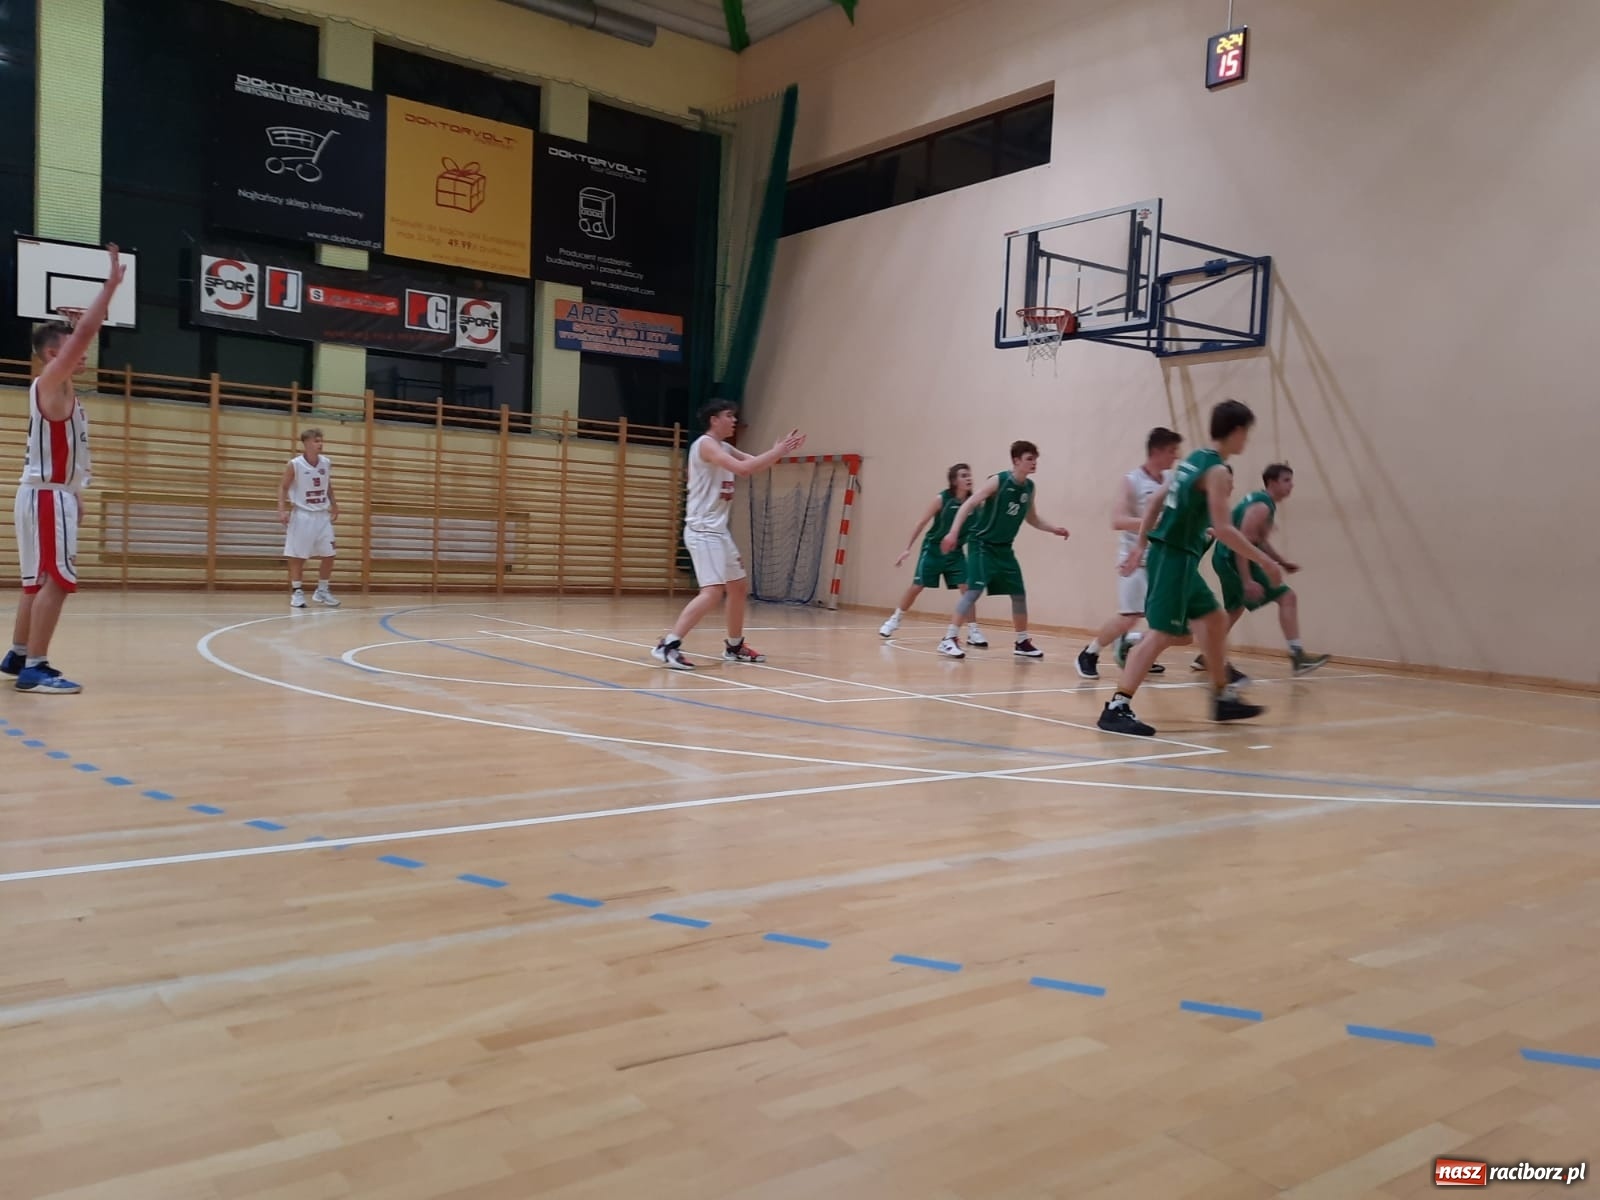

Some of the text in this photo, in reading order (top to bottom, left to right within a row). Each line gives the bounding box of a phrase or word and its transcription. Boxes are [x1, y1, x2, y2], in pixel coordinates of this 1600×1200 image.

[1218, 49, 1240, 77] 15
[236, 73, 368, 109] DOKTORVOLT
[404, 113, 516, 145] DOKTORVOLT
[548, 146, 647, 175] DOKTORVOLT
[566, 303, 619, 325] ARES
